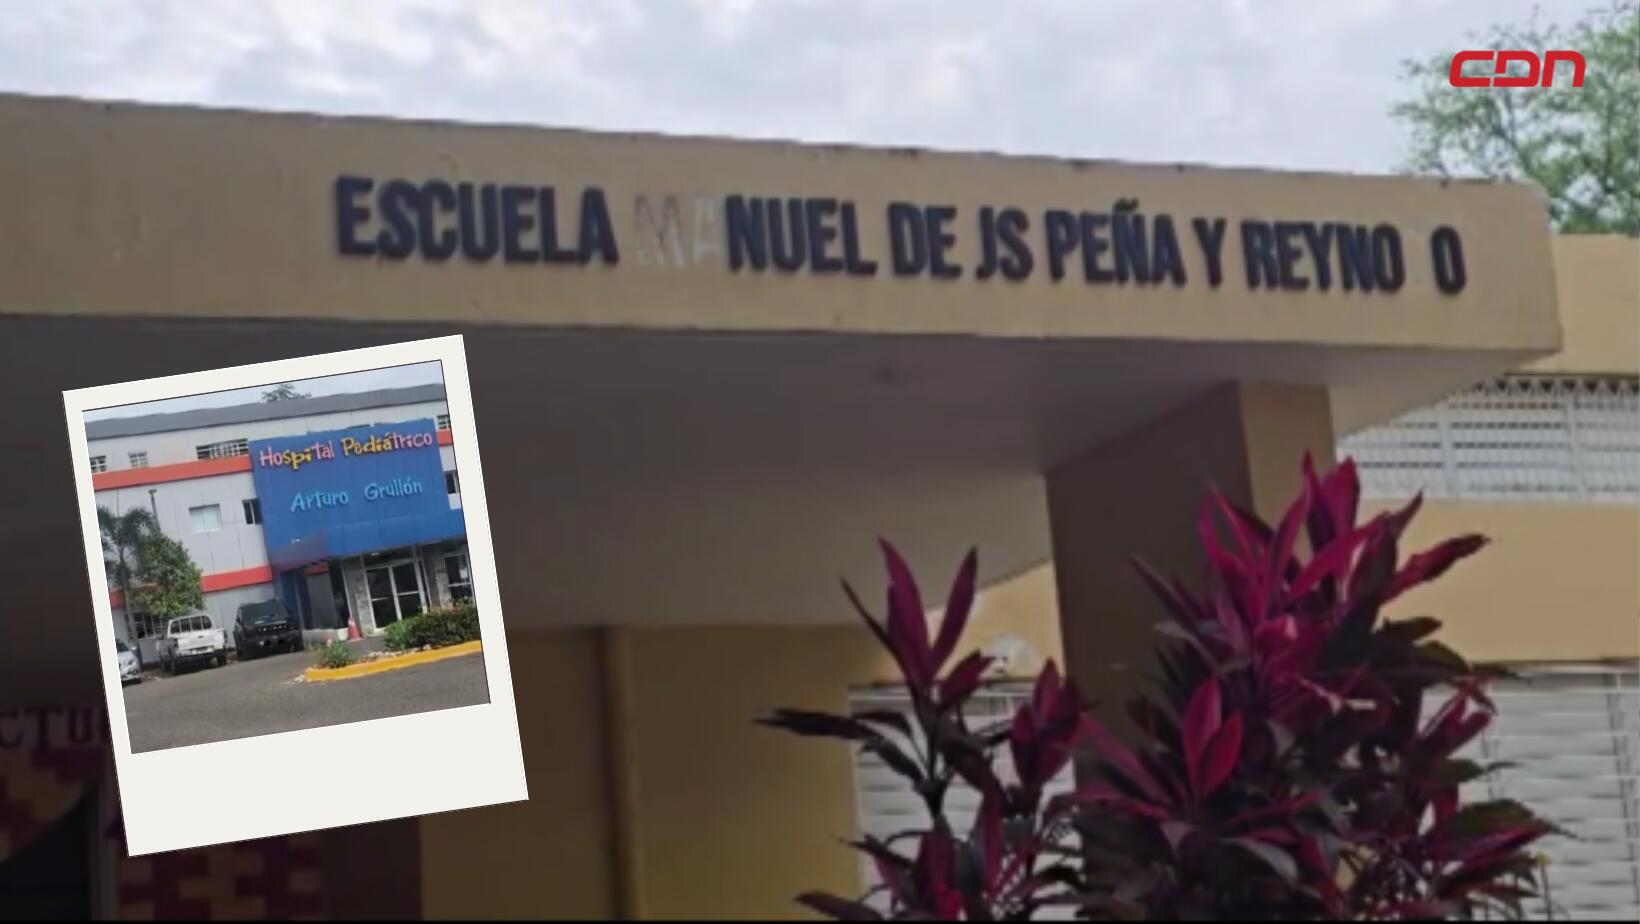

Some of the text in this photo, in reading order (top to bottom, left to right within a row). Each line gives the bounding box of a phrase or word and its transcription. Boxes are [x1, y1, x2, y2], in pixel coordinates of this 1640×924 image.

[336, 176, 620, 264] ESCUELA
[887, 202, 961, 278] DE
[976, 206, 1034, 281] JS
[1045, 198, 1187, 287] PEÑA
[1193, 217, 1226, 288] Y
[1240, 220, 1467, 296] REYNOO
[259, 431, 433, 470] Hospital Pediátrico
[290, 475, 423, 512] Arturo Grullón
[0, 705, 109, 748] CTU
